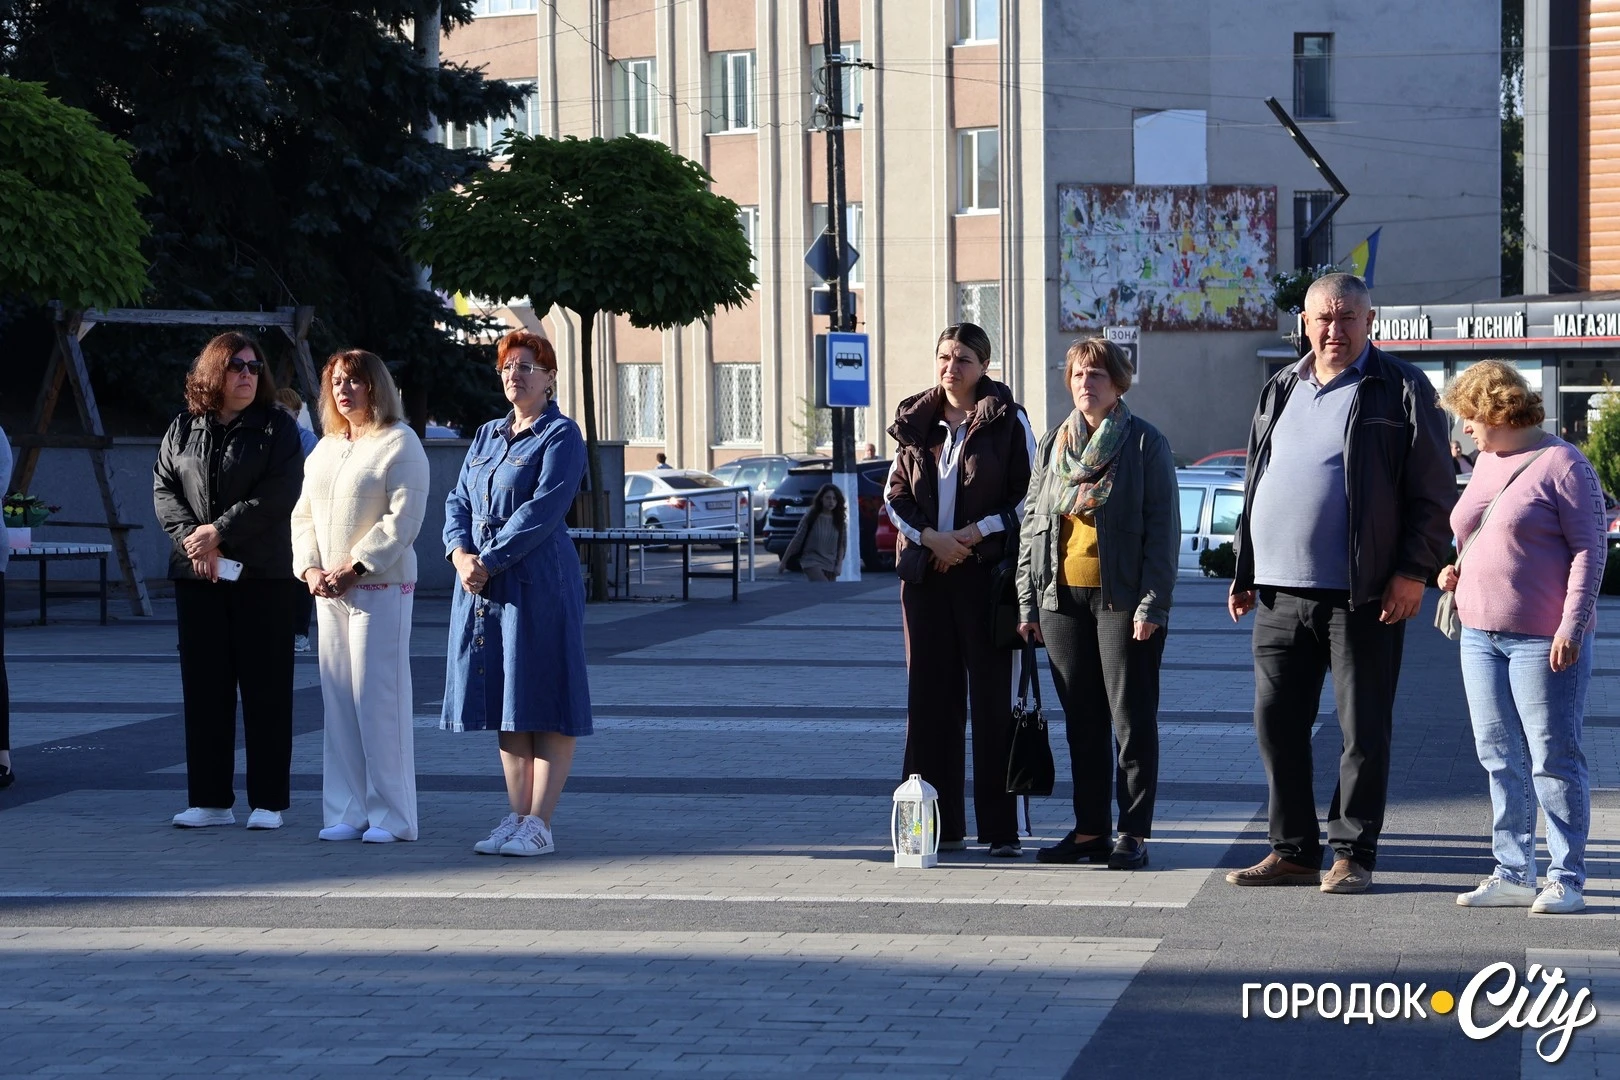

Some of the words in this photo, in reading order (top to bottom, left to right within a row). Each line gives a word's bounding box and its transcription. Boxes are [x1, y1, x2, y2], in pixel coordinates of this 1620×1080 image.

[1111, 330, 1137, 340] ЗОНА
[1367, 314, 1428, 340] РМОВИЙ
[1457, 311, 1523, 338] М'ЯСНИЙ
[1554, 313, 1620, 337] МАГАЗИ
